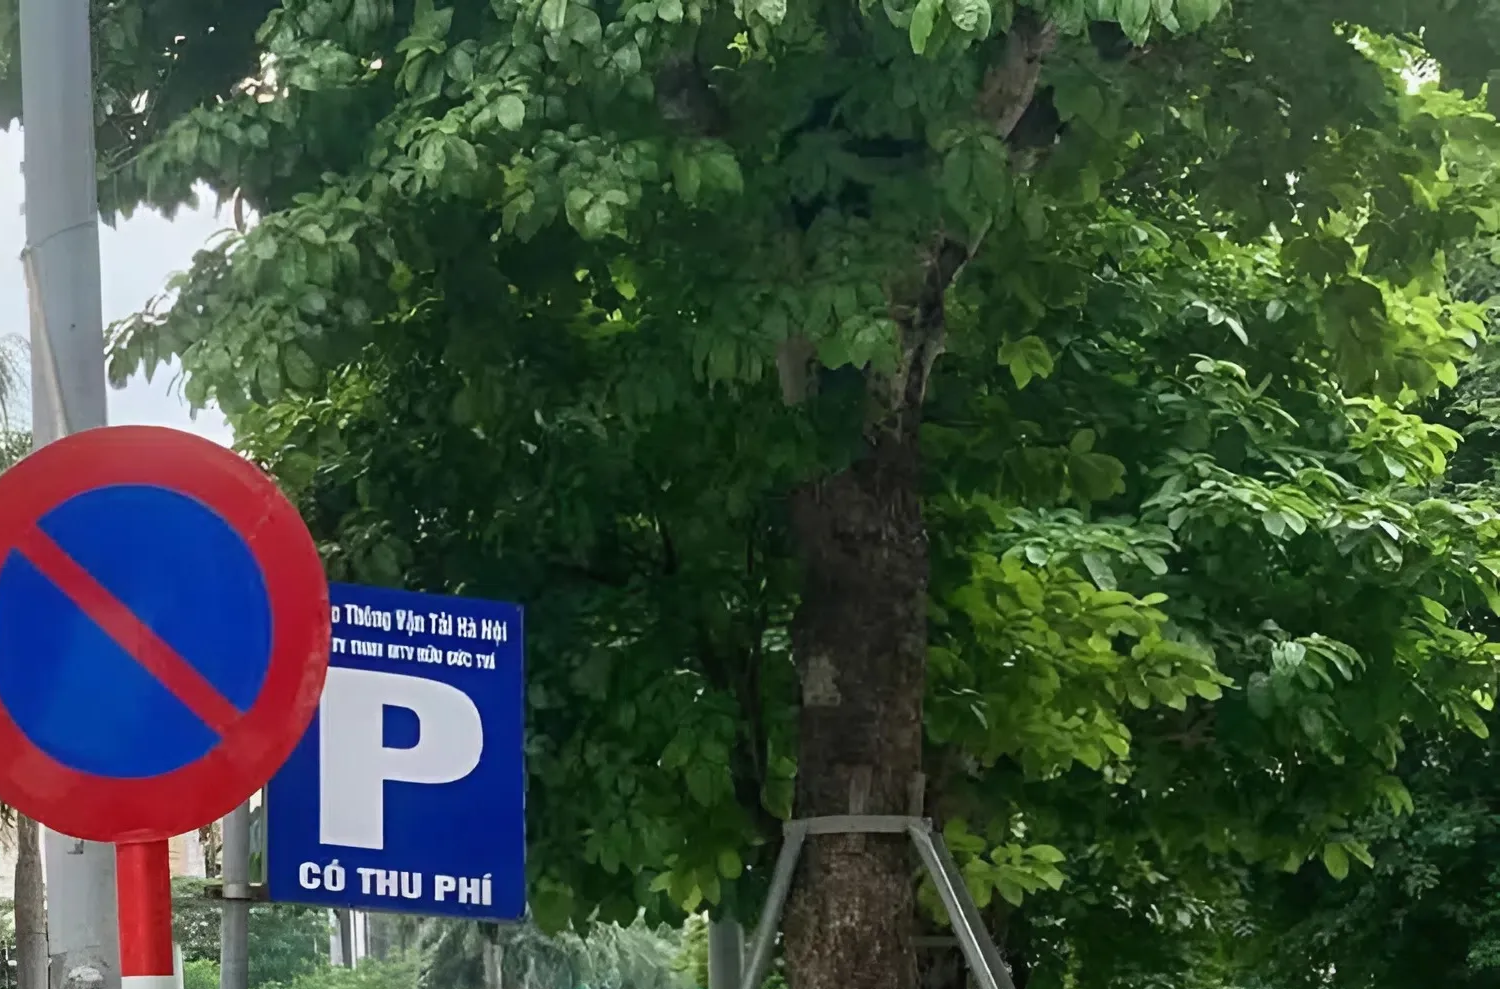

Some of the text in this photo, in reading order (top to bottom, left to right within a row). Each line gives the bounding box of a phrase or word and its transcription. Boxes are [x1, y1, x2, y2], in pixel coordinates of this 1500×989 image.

[344, 603, 392, 632] Thống
[395, 609, 425, 637] Vận
[457, 616, 477, 639] Hà
[319, 666, 484, 850] P
[300, 858, 492, 906] CÓ THU PHÍ
